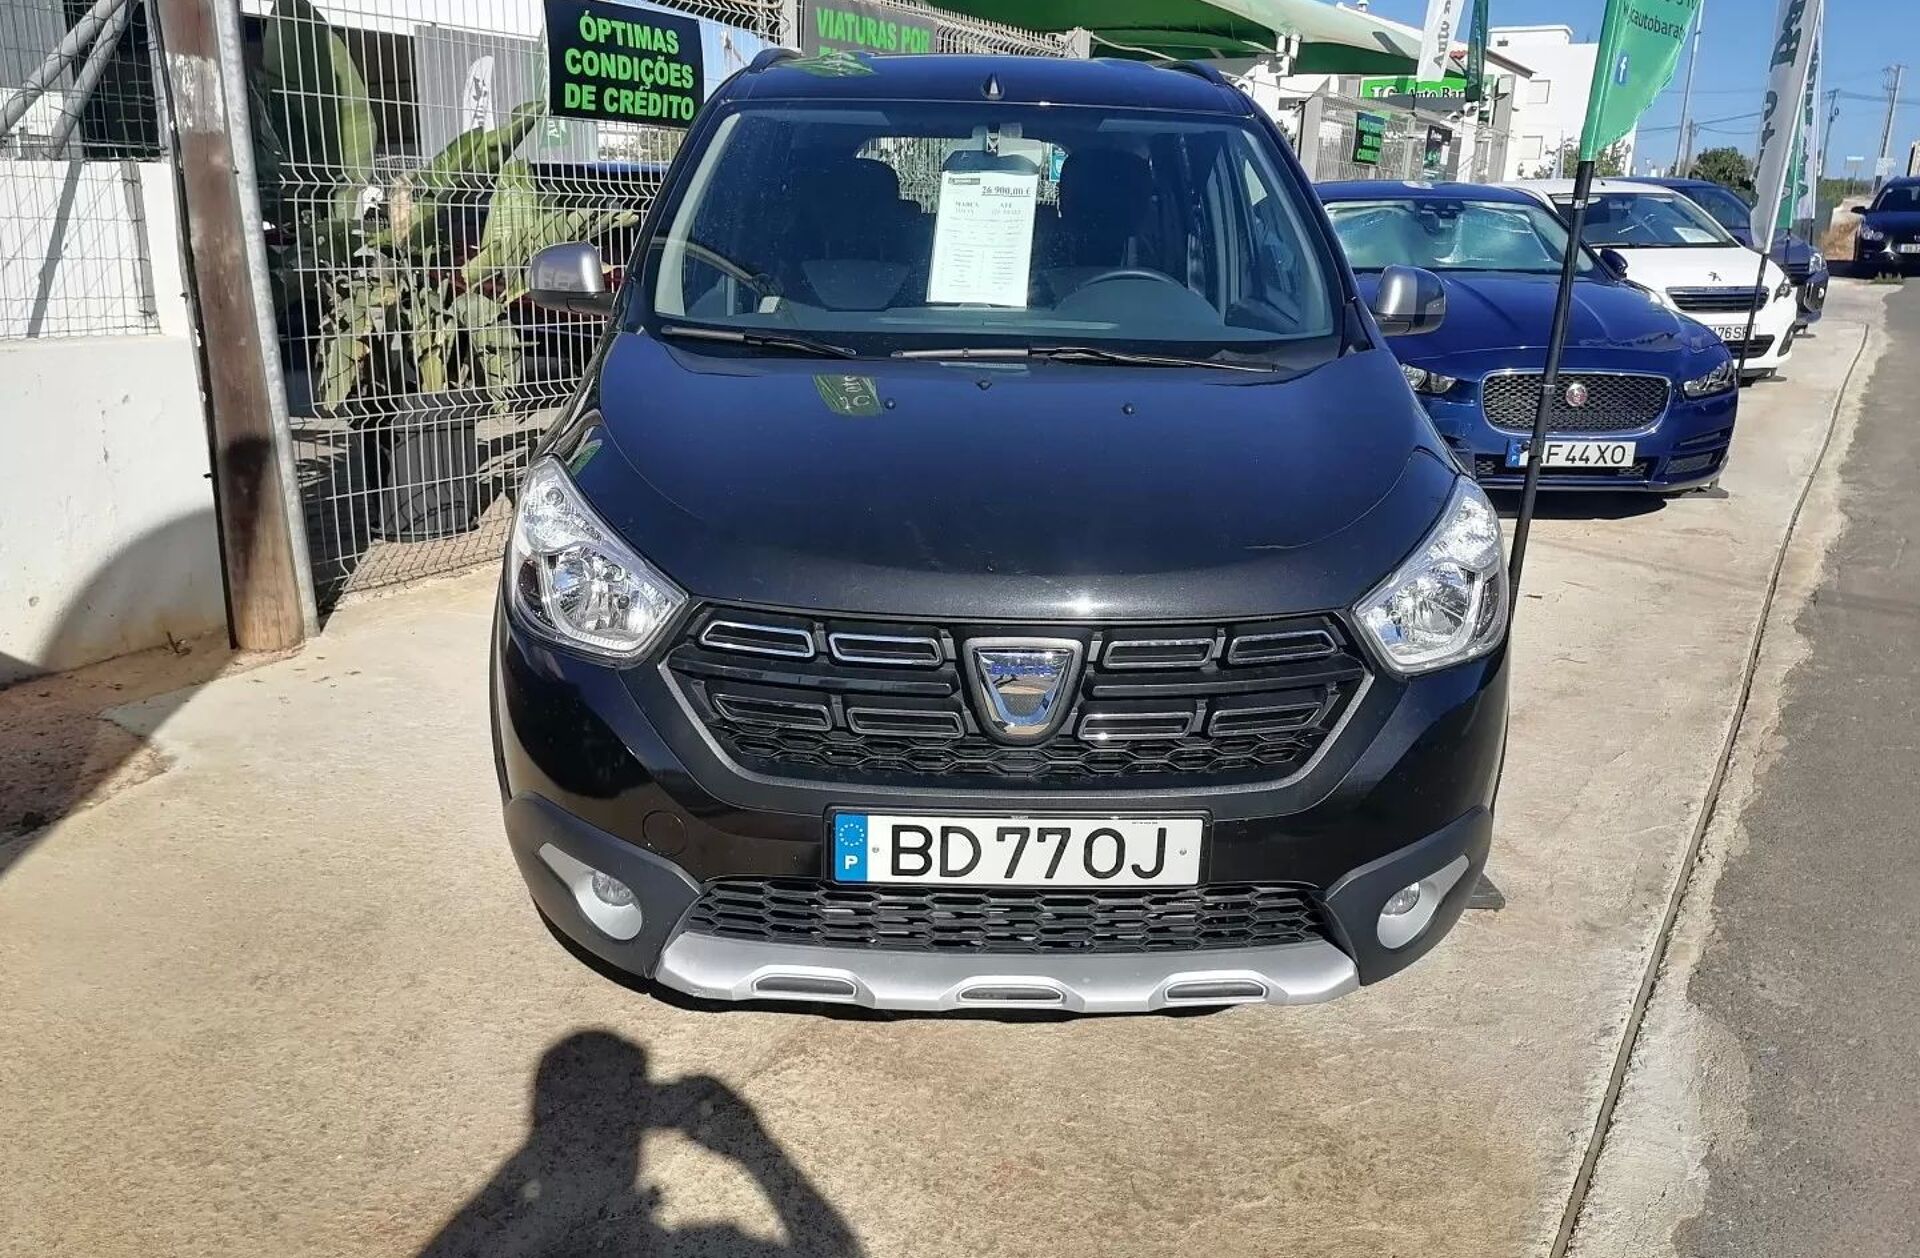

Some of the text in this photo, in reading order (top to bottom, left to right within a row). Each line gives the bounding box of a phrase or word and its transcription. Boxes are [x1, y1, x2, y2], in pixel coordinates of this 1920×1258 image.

[579, 10, 680, 54] ÓPTIMAS
[816, 7, 930, 53] VIATURAS POR
[565, 48, 694, 90] CONDIÇÕES
[564, 83, 695, 120] DE CRÉDITO
[1442, 87, 1465, 98] Bar
[1537, 444, 1626, 465] F 44 XO
[844, 854, 858, 870] P
[890, 823, 1168, 880] BD 77 OJ
